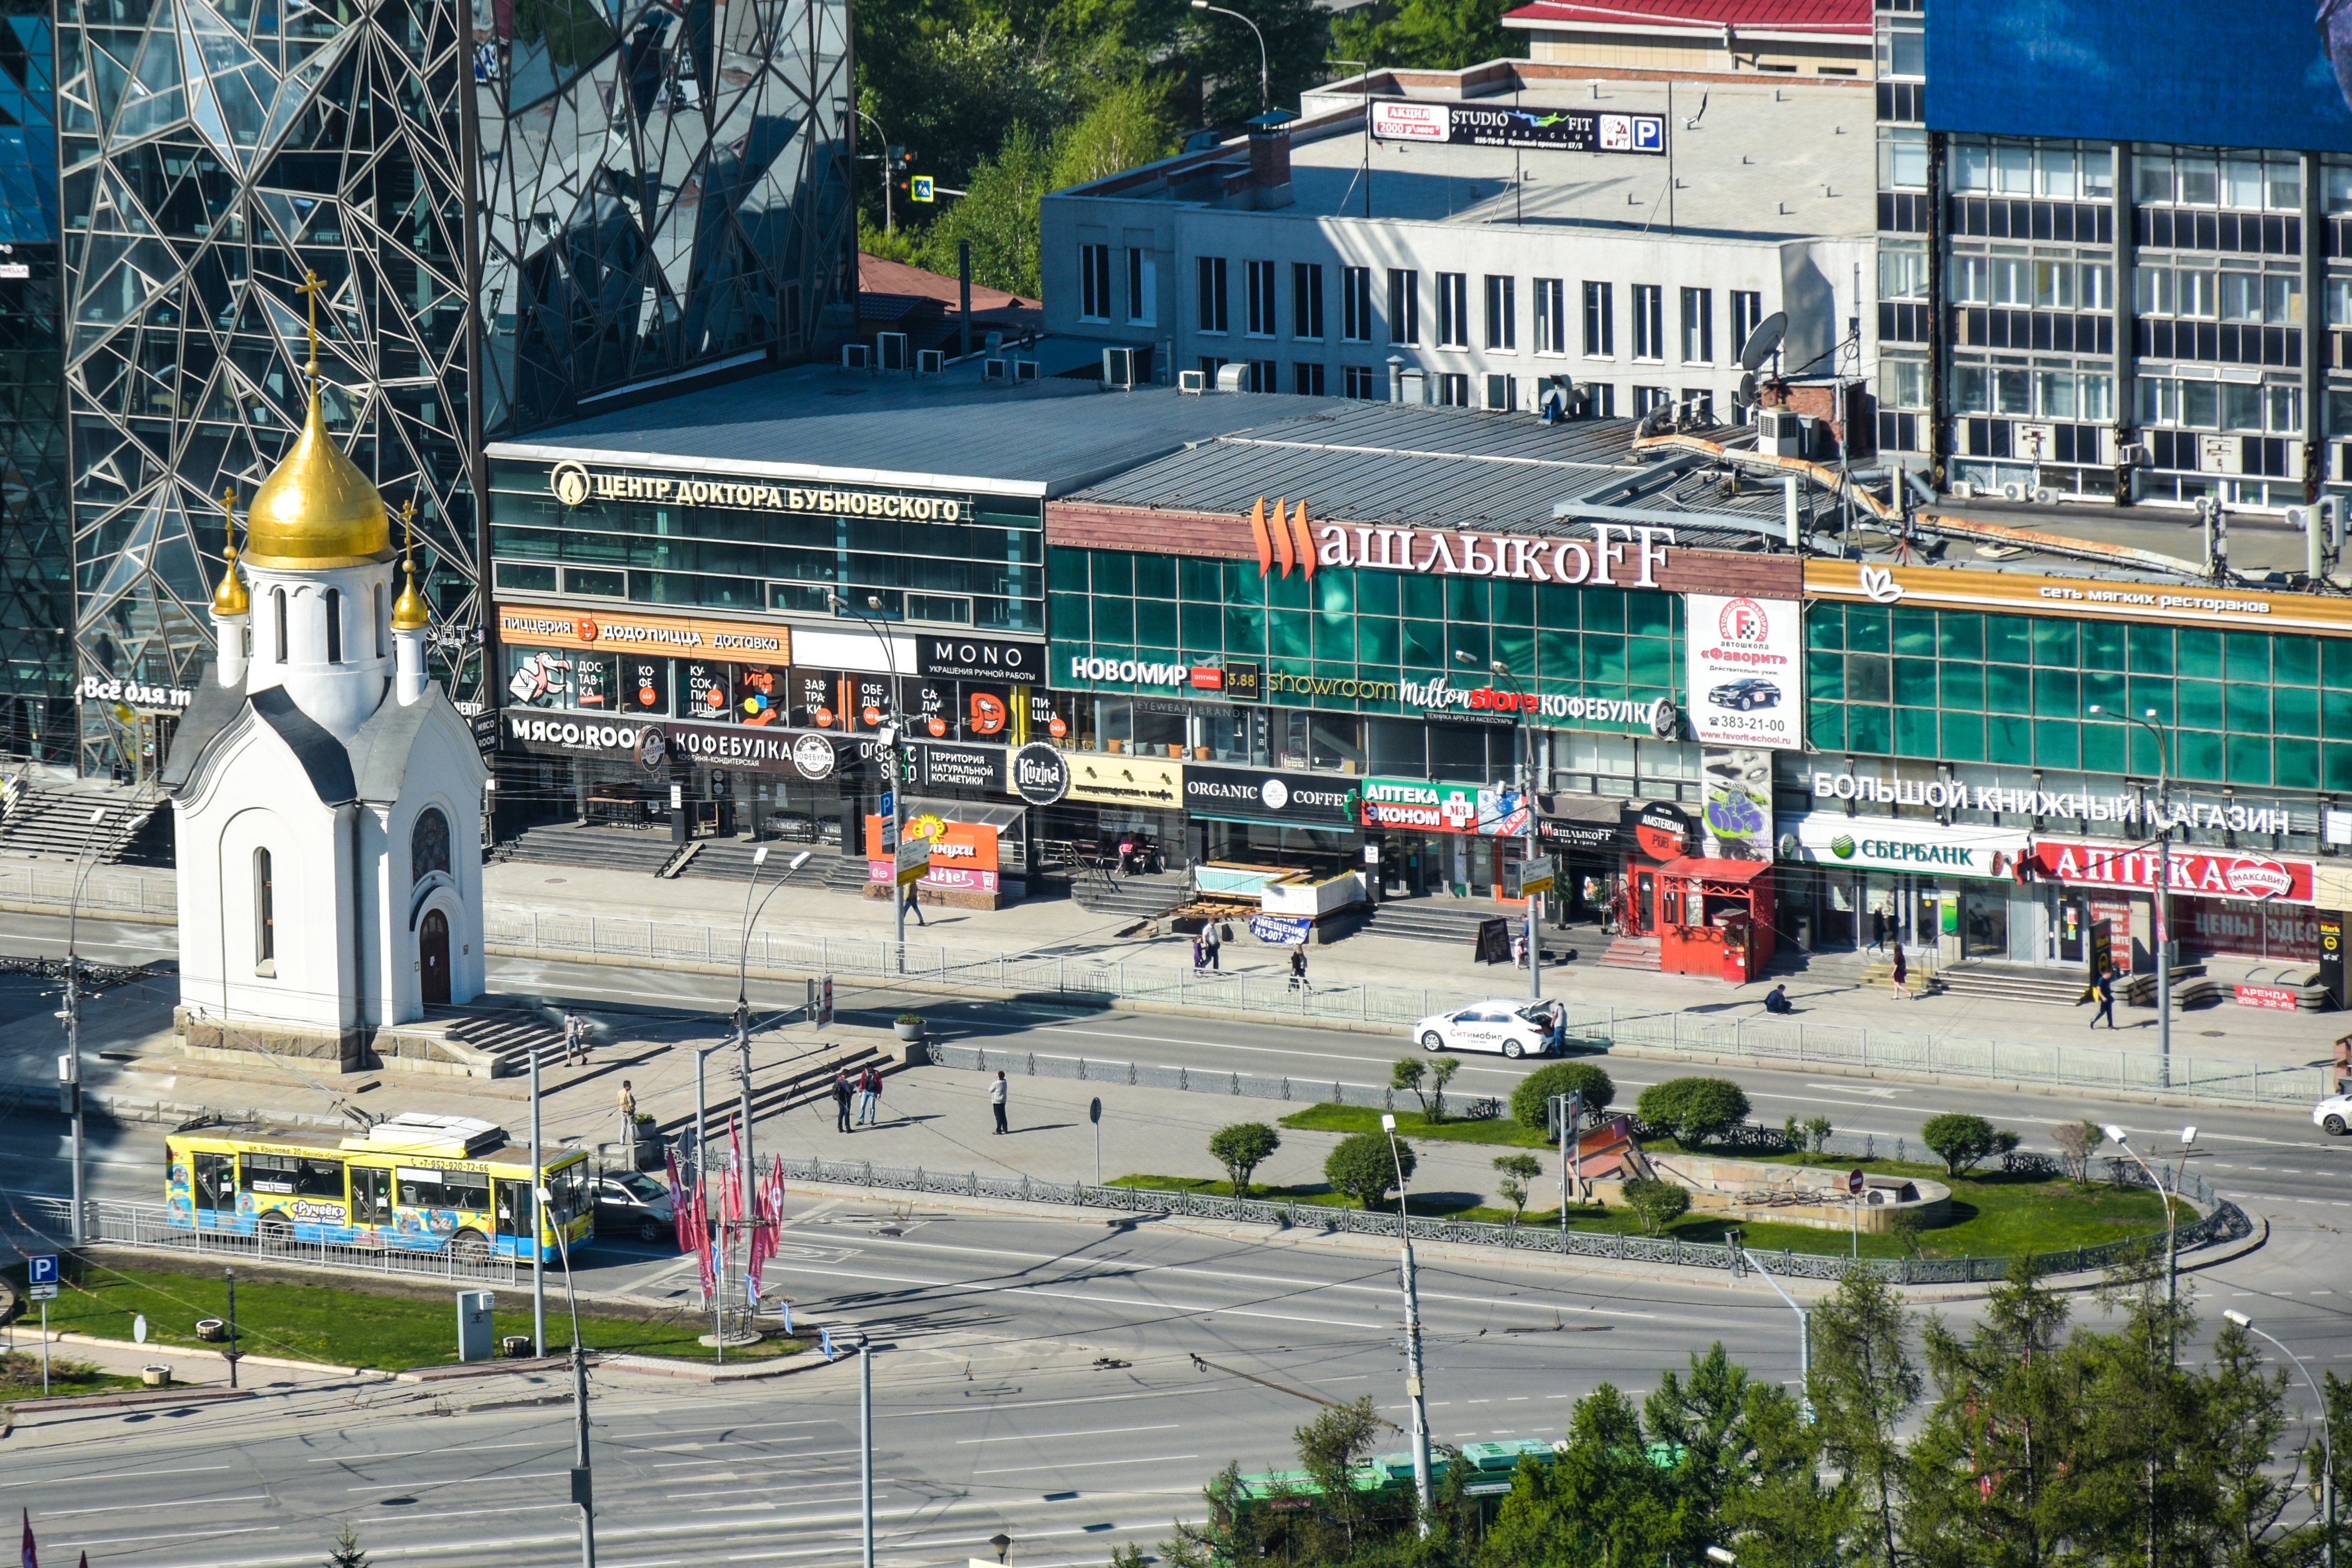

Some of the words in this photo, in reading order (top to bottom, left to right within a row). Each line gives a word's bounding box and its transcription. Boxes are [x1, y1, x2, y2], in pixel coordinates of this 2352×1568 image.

[1390, 107, 1430, 120] АКЦИЯ
[1452, 110, 1508, 127] STUDIO
[1568, 117, 1592, 131] FIT
[1380, 123, 1403, 133] 2000
[1638, 125, 1656, 146] P
[598, 474, 671, 501] ЦЕНТР
[676, 480, 782, 508] ДОКТОРА
[789, 489, 959, 521] БУБНОВСКОГО
[2041, 585, 2082, 600] сеть
[2089, 589, 2154, 605] мягких
[2160, 594, 2270, 614] ресторанов
[503, 617, 572, 635] пиццерия
[713, 634, 779, 651] доставка
[1720, 641, 1769, 650] автошкола
[1701, 647, 1787, 665] «Фаворит»
[929, 665, 973, 675] УКРАШЕНИЯ
[975, 669, 1004, 678] РУЧНОЙ
[1006, 672, 1035, 680] РАБОТЫ
[1072, 657, 1188, 686] НОВОМИР
[1194, 674, 1220, 682] оптика
[639, 678, 652, 688] ФЕ
[691, 678, 712, 689] СОК
[1229, 673, 1255, 687] 3.88
[1269, 669, 1397, 700] showroom
[83, 676, 122, 699] Всё
[125, 681, 166, 705] для
[580, 687, 594, 697] КА
[691, 702, 715, 714] ЦЦЫ
[807, 704, 821, 714] КИ
[862, 696, 880, 708] ДЫ
[1137, 700, 1188, 713] EYEWEAR
[1198, 706, 1248, 719] BRANDS
[1032, 710, 1057, 722] ЦЦА
[1722, 715, 1785, 731] 383-21-00
[478, 720, 495, 731] МЯСО
[512, 719, 580, 743] МЯСО
[676, 732, 792, 761] КОФЕБУЛКА
[795, 752, 833, 762] КОФЕБУЛКА
[931, 752, 985, 765] ТЕРРИТОРИЯ
[931, 763, 994, 777] НАТУРАЛЬНОЙ
[1019, 758, 1060, 785] Kuzina
[932, 773, 984, 786] КОСМЕТИКИ
[1188, 782, 1258, 800] ORGANIC
[1366, 784, 1440, 805] АПТЕКА
[1815, 772, 1967, 809] БОЛЬШОЙ
[1978, 786, 2136, 823] КНИЖНЫЙ
[884, 797, 890, 814] P
[1366, 806, 1441, 825] ЭКОНОМ
[1642, 814, 1684, 832] AMSTERDAM
[1653, 834, 1669, 848] PUB
[1862, 840, 1974, 866] СБЕРБАНК
[2233, 874, 2285, 887] МАКСАВИТ
[2196, 912, 2255, 936] ЦЕНЫ
[2268, 920, 2318, 943] ЗДЕС
[2111, 935, 2130, 945] АЙТЕ
[2242, 987, 2288, 1000] АРЕНДА
[1450, 1029, 1502, 1041] Ситимобил
[420, 1159, 489, 1171] +7-952-920-72-66
[268, 1183, 275, 1191] 13
[291, 1200, 346, 1216] «Ручеёк»
[36, 1259, 51, 1279] P
